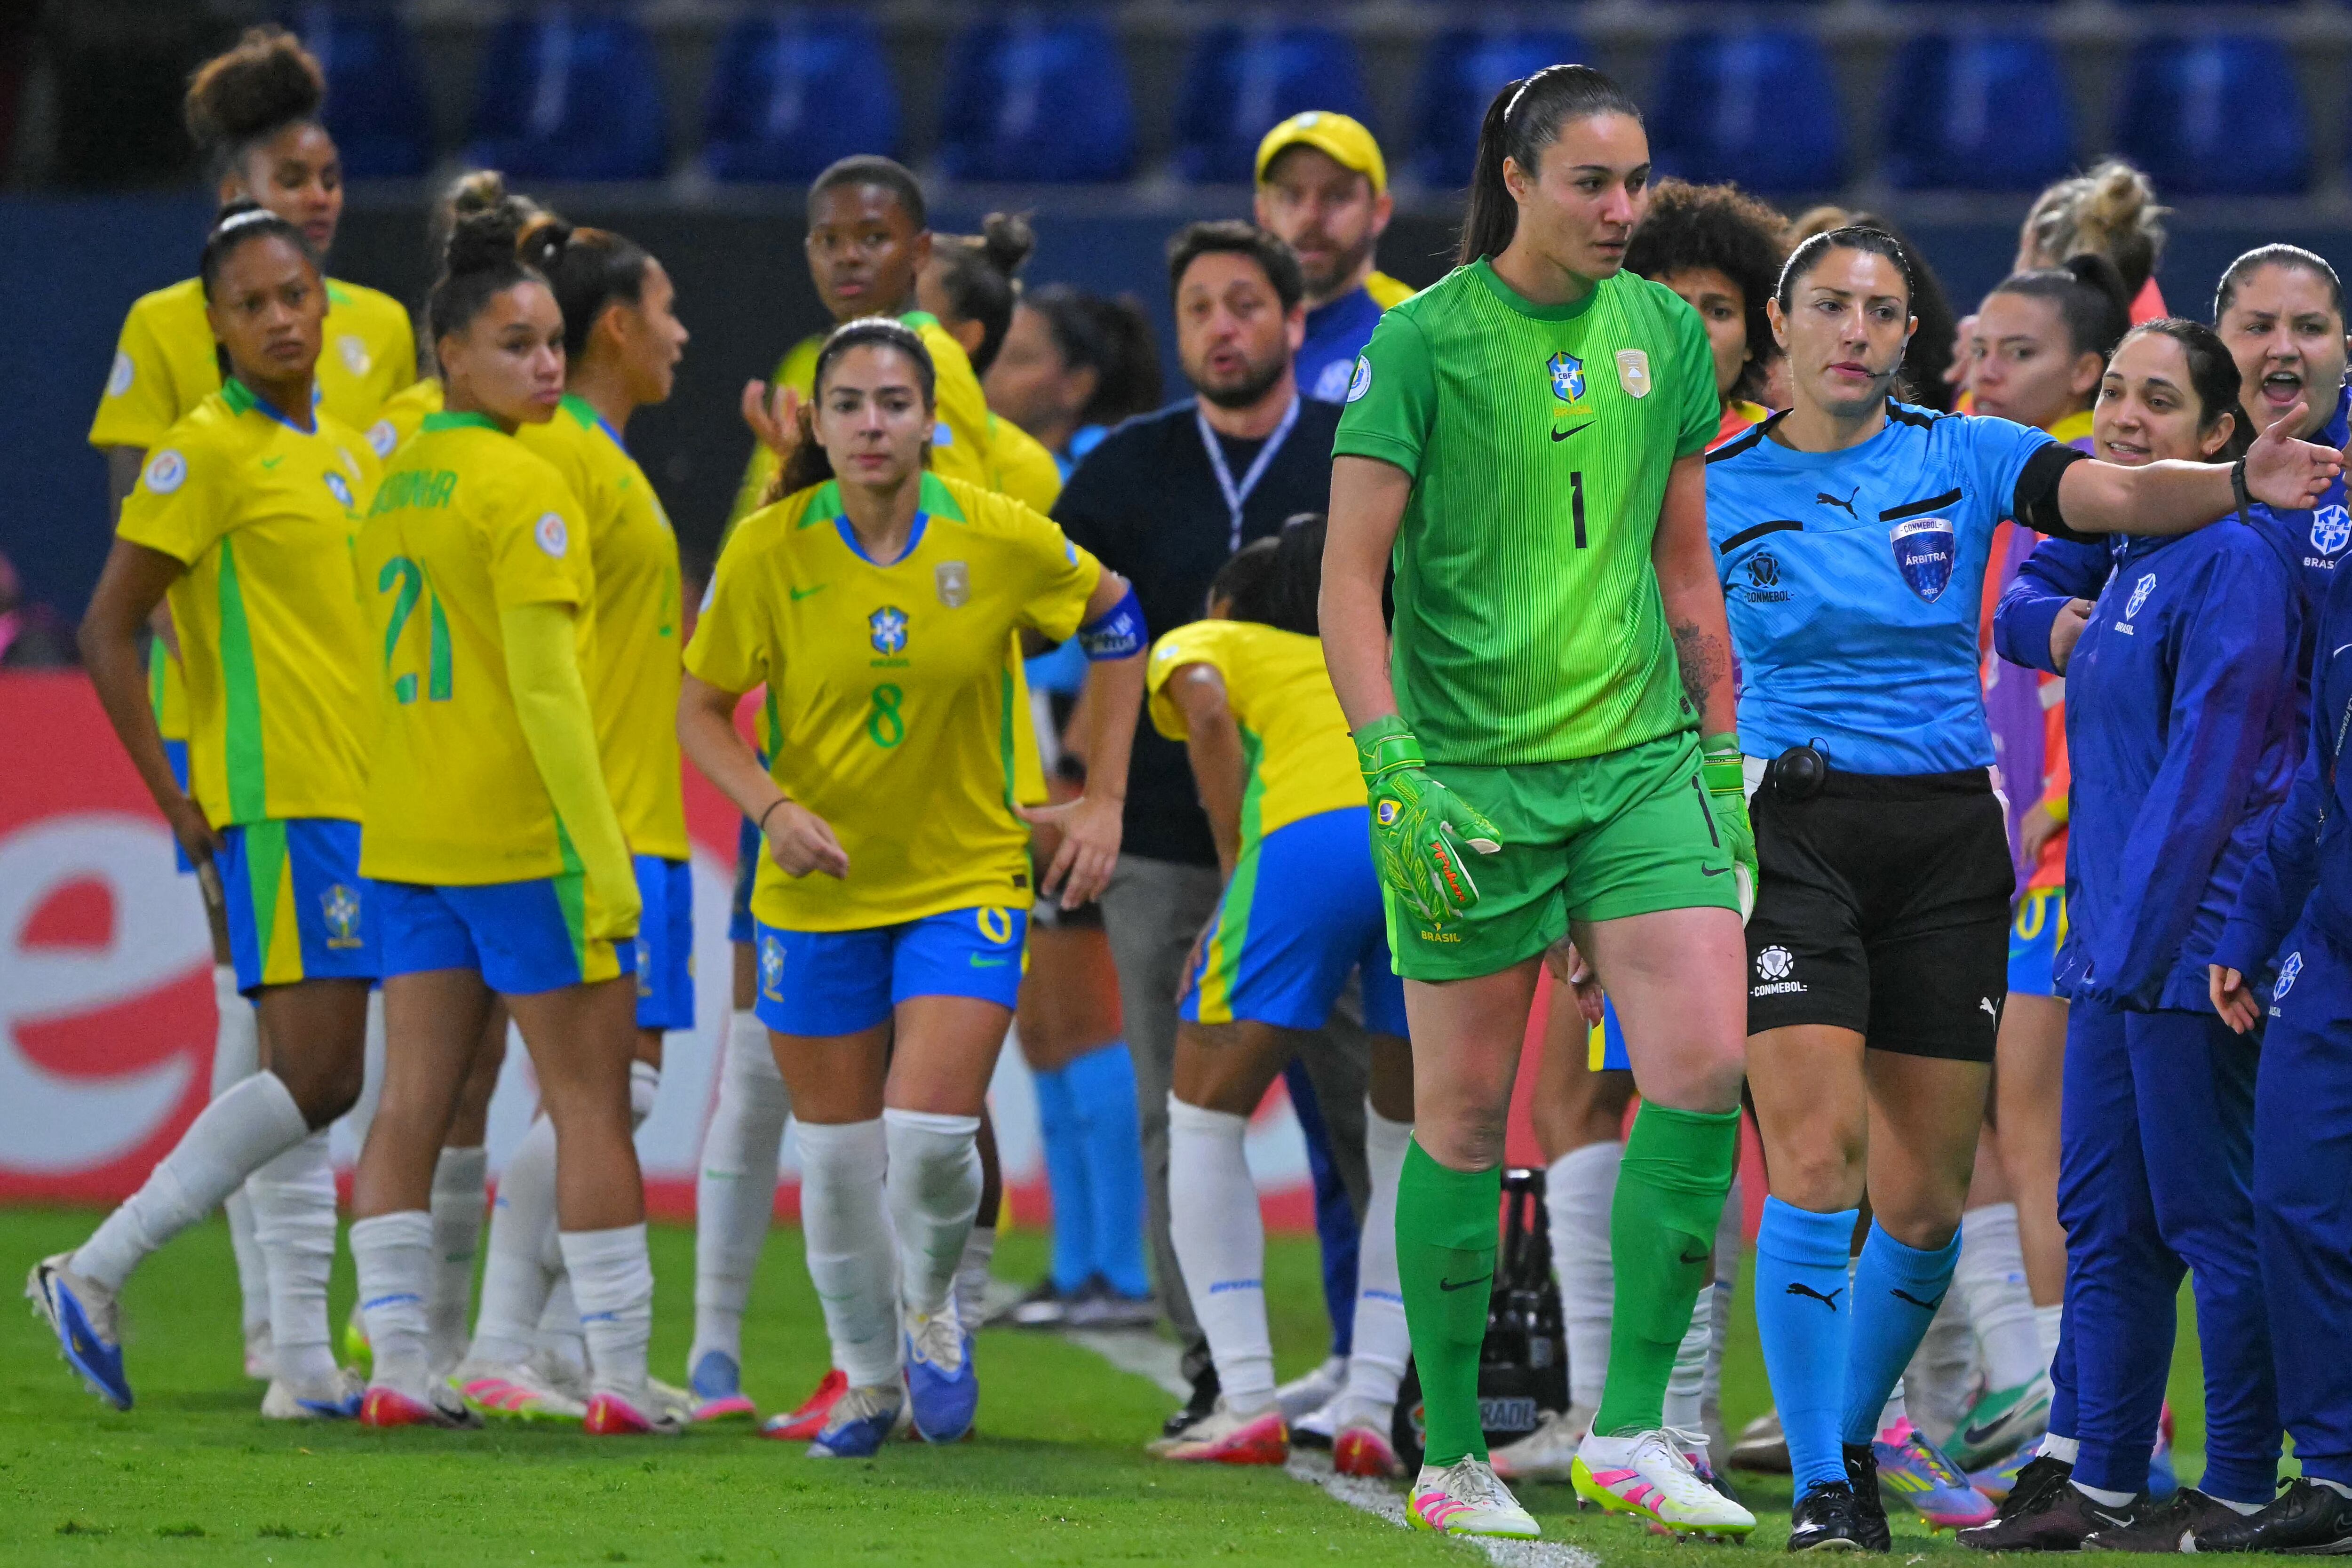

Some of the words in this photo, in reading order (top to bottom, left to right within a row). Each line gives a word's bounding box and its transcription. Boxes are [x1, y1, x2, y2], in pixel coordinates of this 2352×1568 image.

[1570, 471, 1587, 549] 1
[1906, 551, 1947, 565] ÁRBITRA
[2304, 557, 2335, 569] BRAS
[378, 555, 453, 704] 21
[2115, 621, 2134, 636] BRASIL
[868, 683, 905, 748] 8
[1421, 930, 1461, 942] BRASIL
